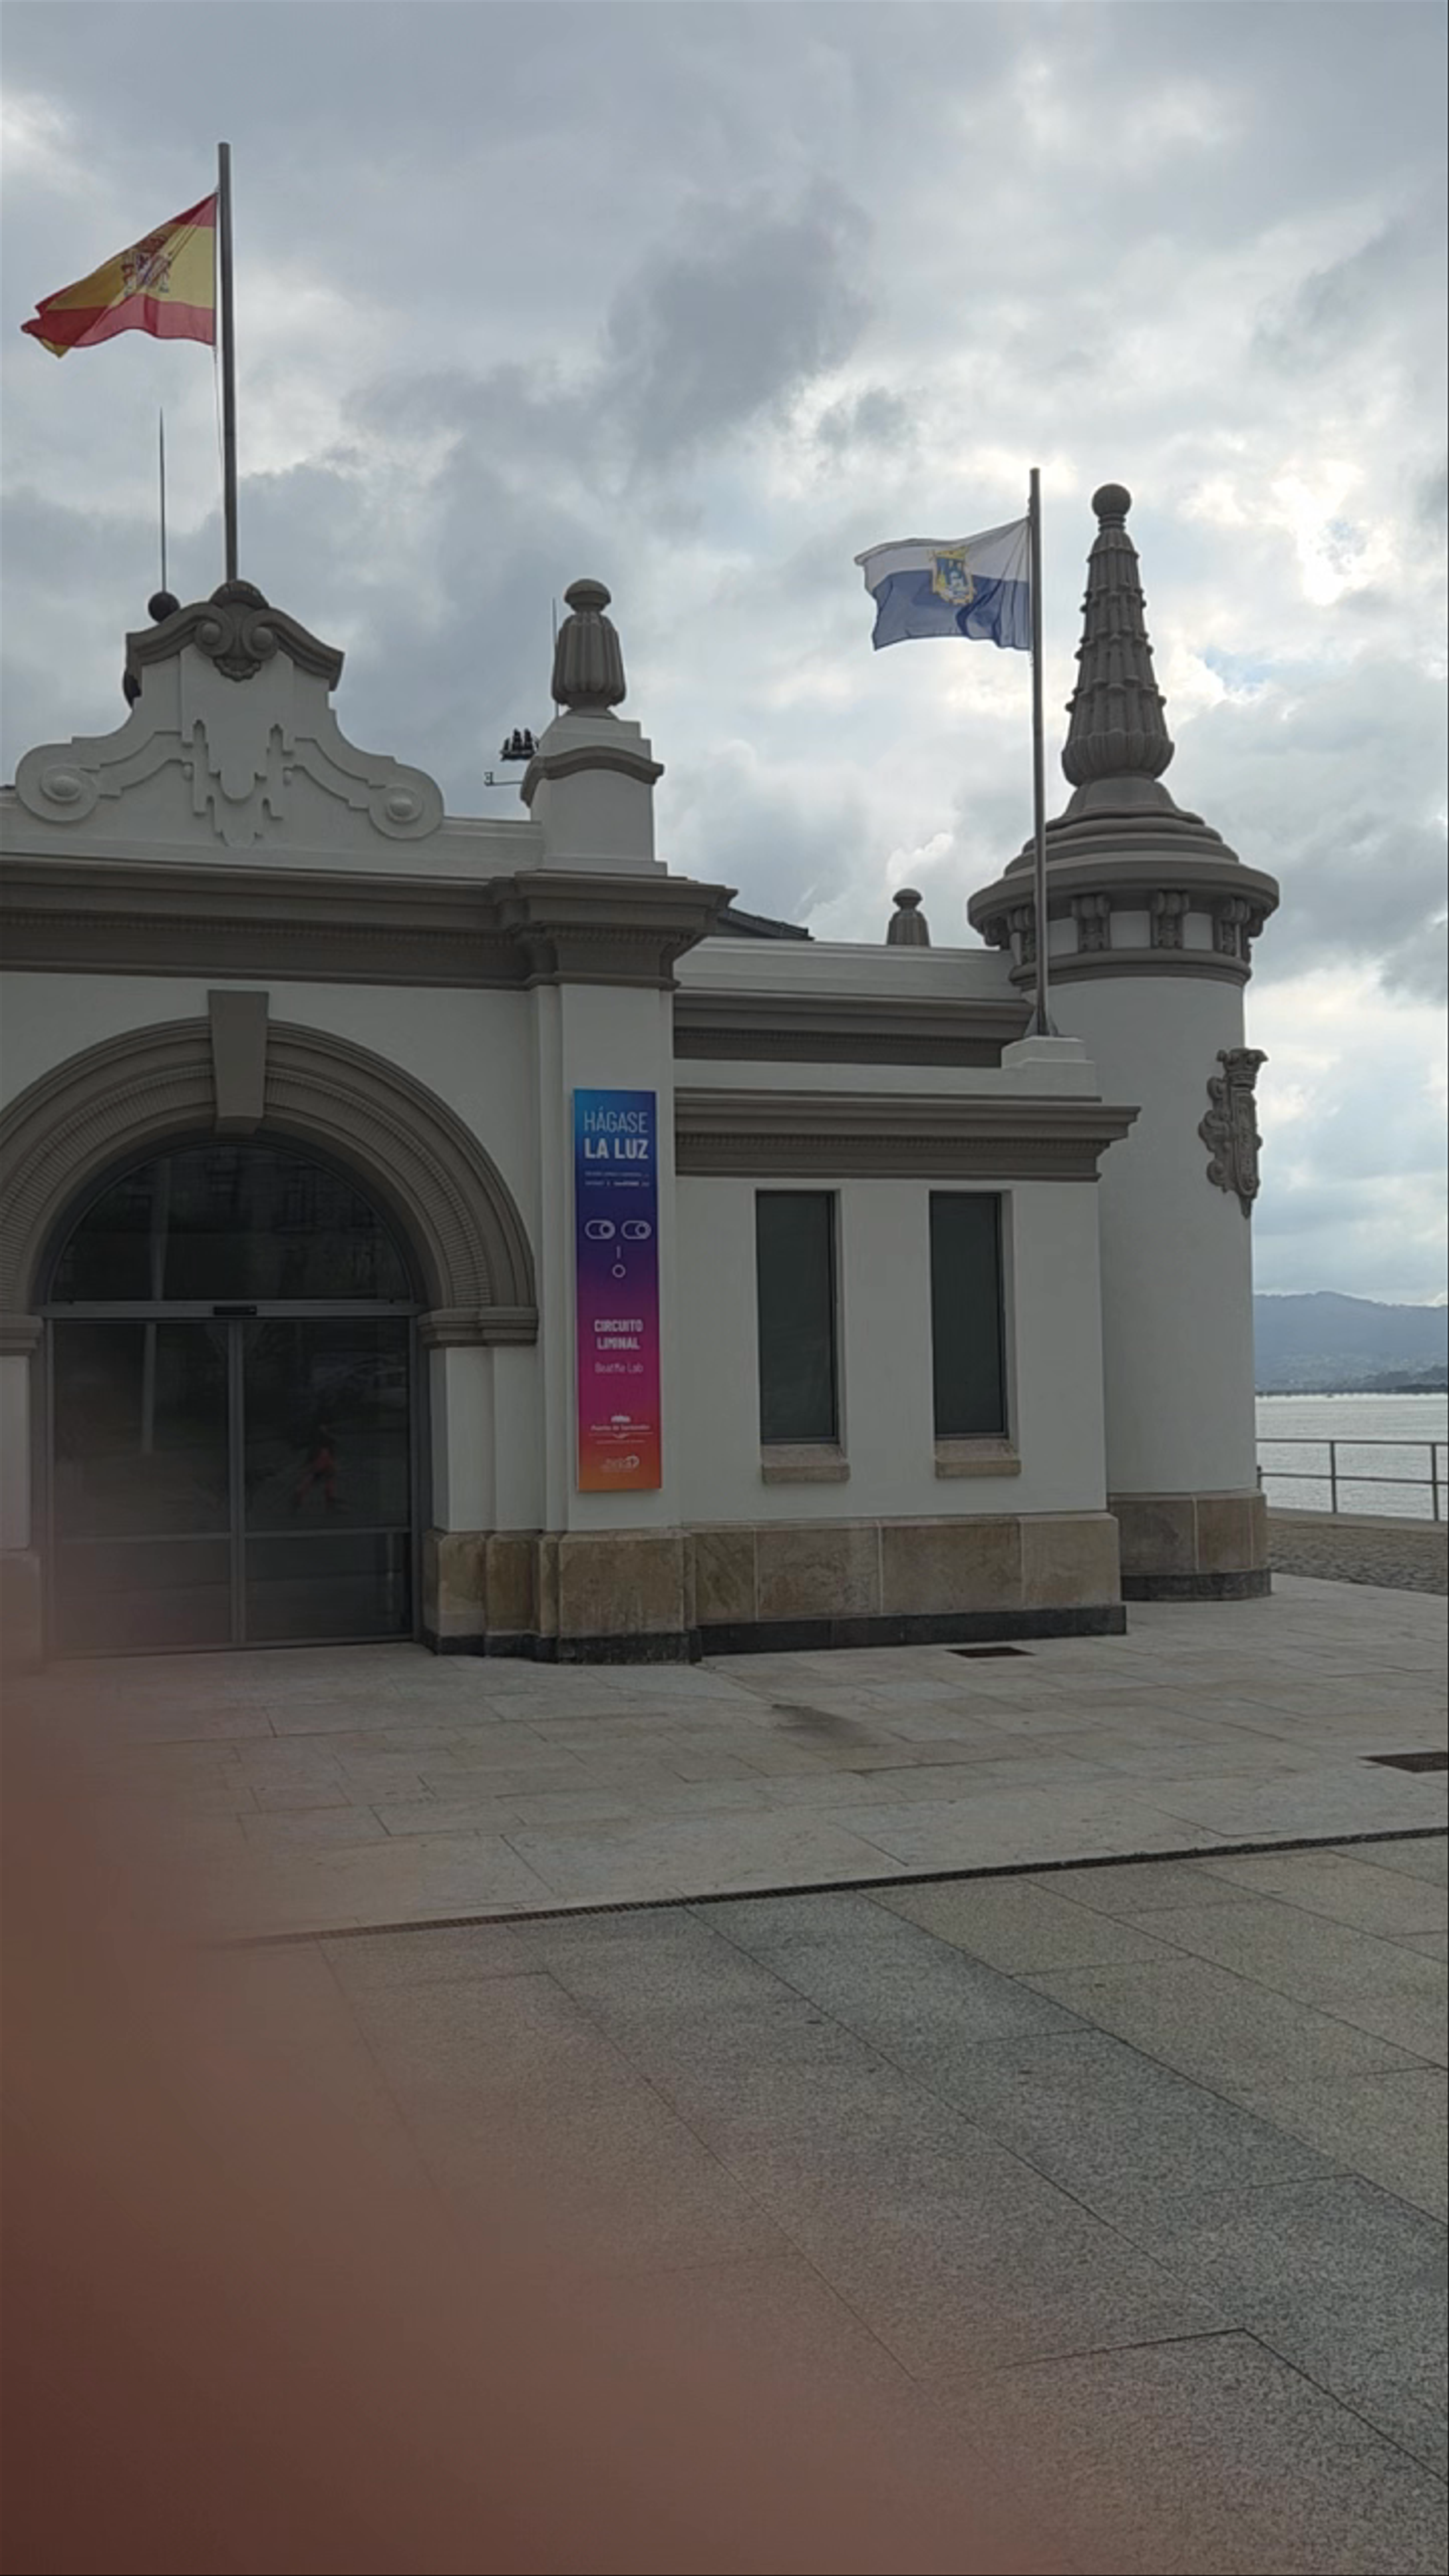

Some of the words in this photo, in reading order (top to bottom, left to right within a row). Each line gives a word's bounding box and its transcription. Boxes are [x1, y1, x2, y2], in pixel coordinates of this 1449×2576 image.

[585, 1106, 649, 1133] HÁGASE
[585, 1138, 609, 1159] LA
[614, 1138, 649, 1159] LUZ
[594, 1319, 643, 1332] CIRCUITO
[597, 1337, 641, 1350] LIMINAL
[627, 1362, 643, 1373] Lab
